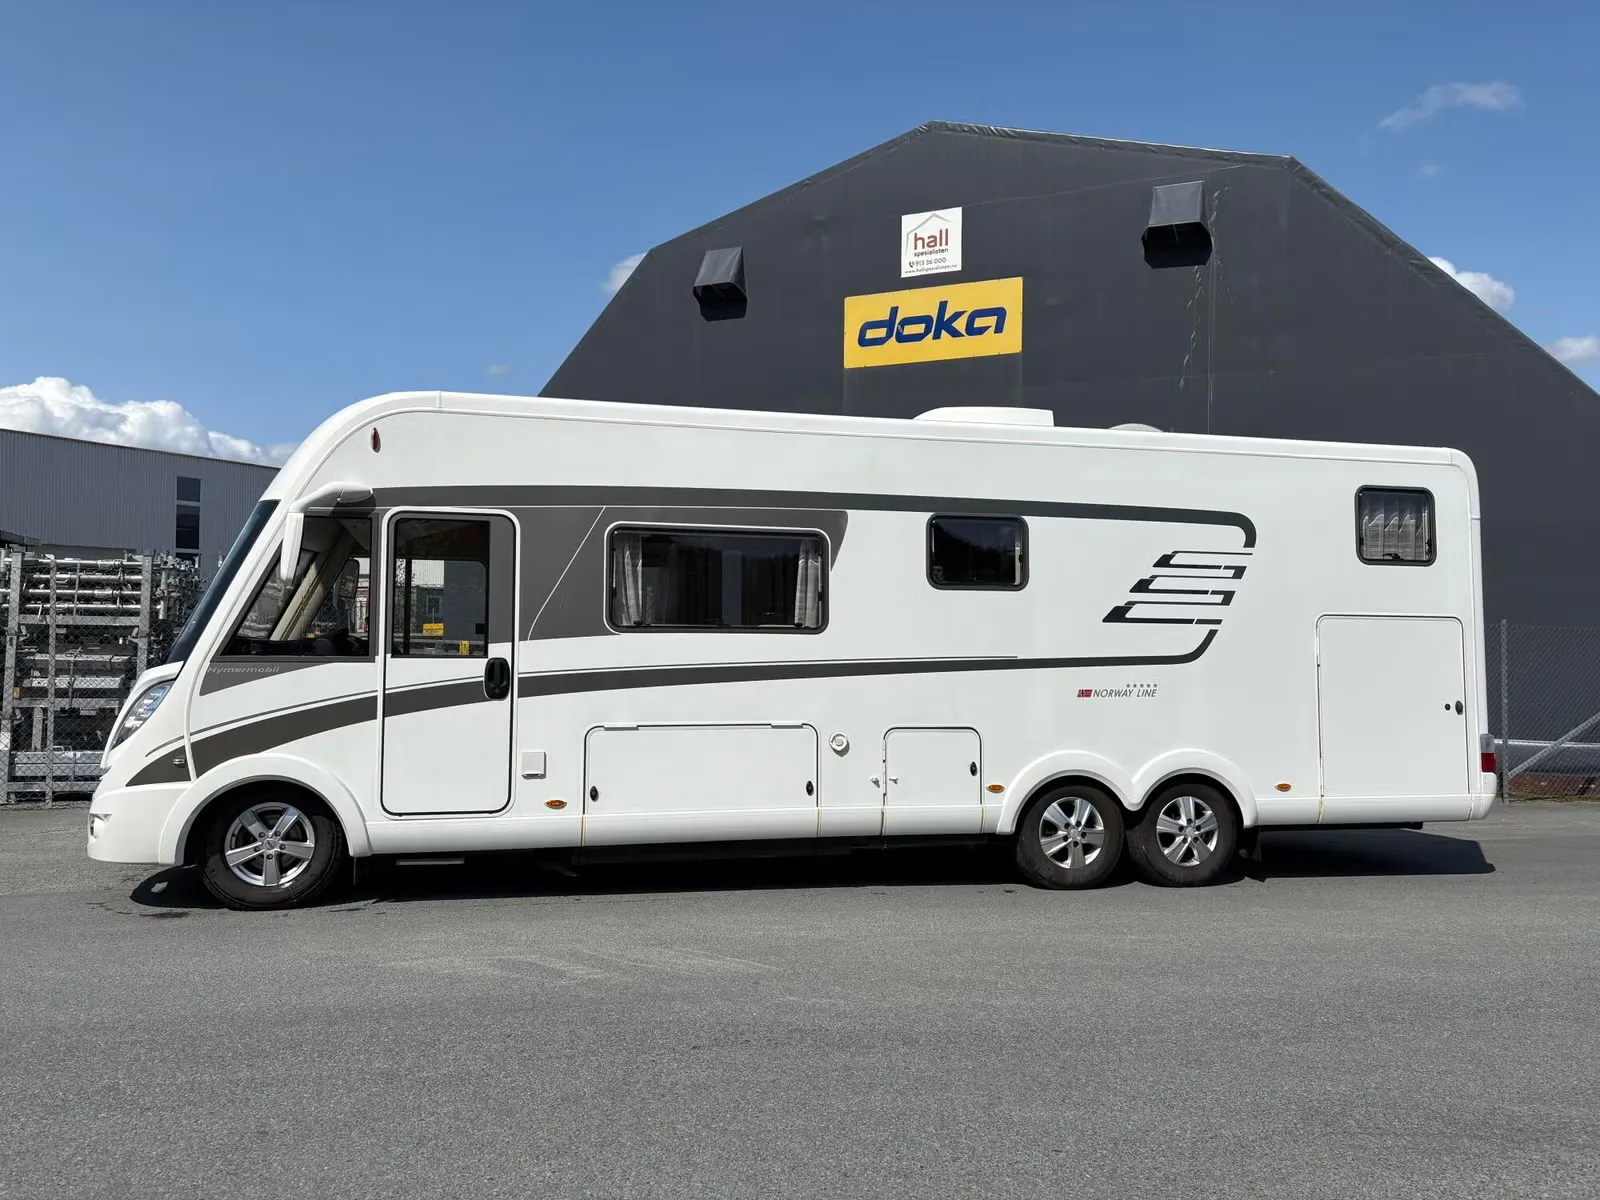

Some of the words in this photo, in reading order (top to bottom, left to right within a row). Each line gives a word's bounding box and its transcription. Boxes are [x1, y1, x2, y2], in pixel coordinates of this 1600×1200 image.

[914, 228, 949, 250] hall
[914, 248, 949, 257] spesialisten
[858, 300, 1007, 347] doka
[1093, 689, 1133, 697] NORWAY
[1136, 689, 1157, 697] LINE
